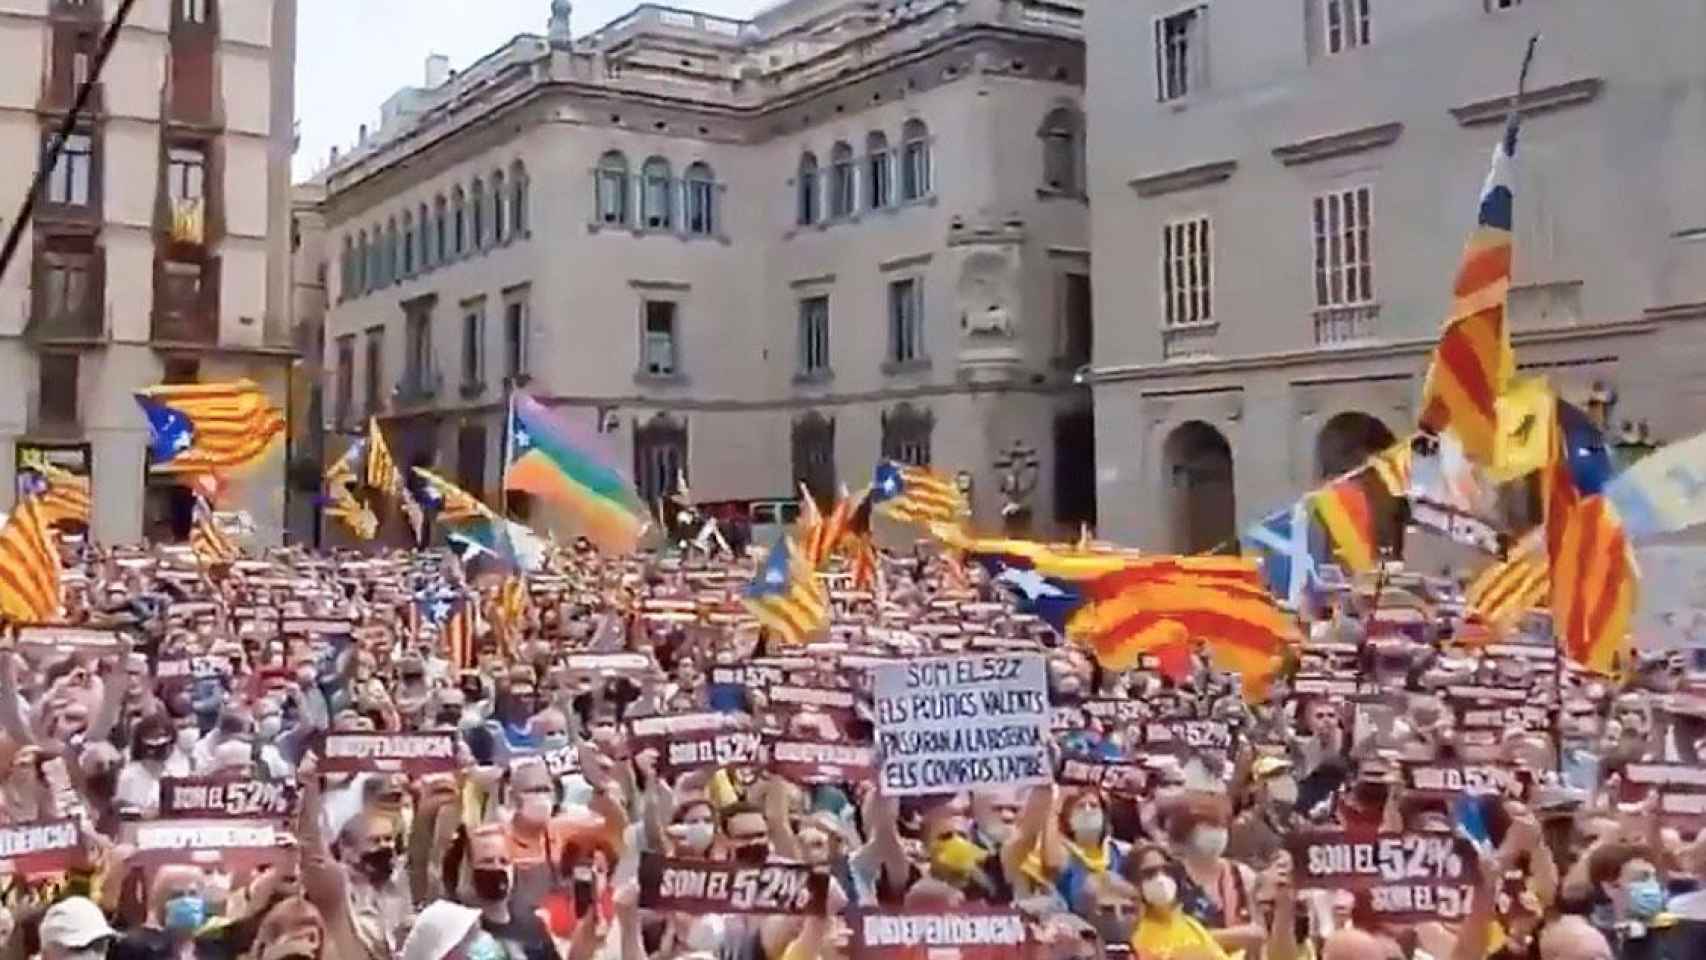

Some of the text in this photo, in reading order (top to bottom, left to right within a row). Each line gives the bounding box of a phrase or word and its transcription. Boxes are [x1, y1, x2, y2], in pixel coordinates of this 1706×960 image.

[906, 662, 951, 689] SOM
[956, 660, 980, 685] EL
[878, 696, 908, 725] ELS
[886, 761, 918, 788] ELS
[1353, 843, 1380, 874] EL
[1379, 833, 1463, 882] 52%
[659, 866, 811, 911] SOM EL 52%
